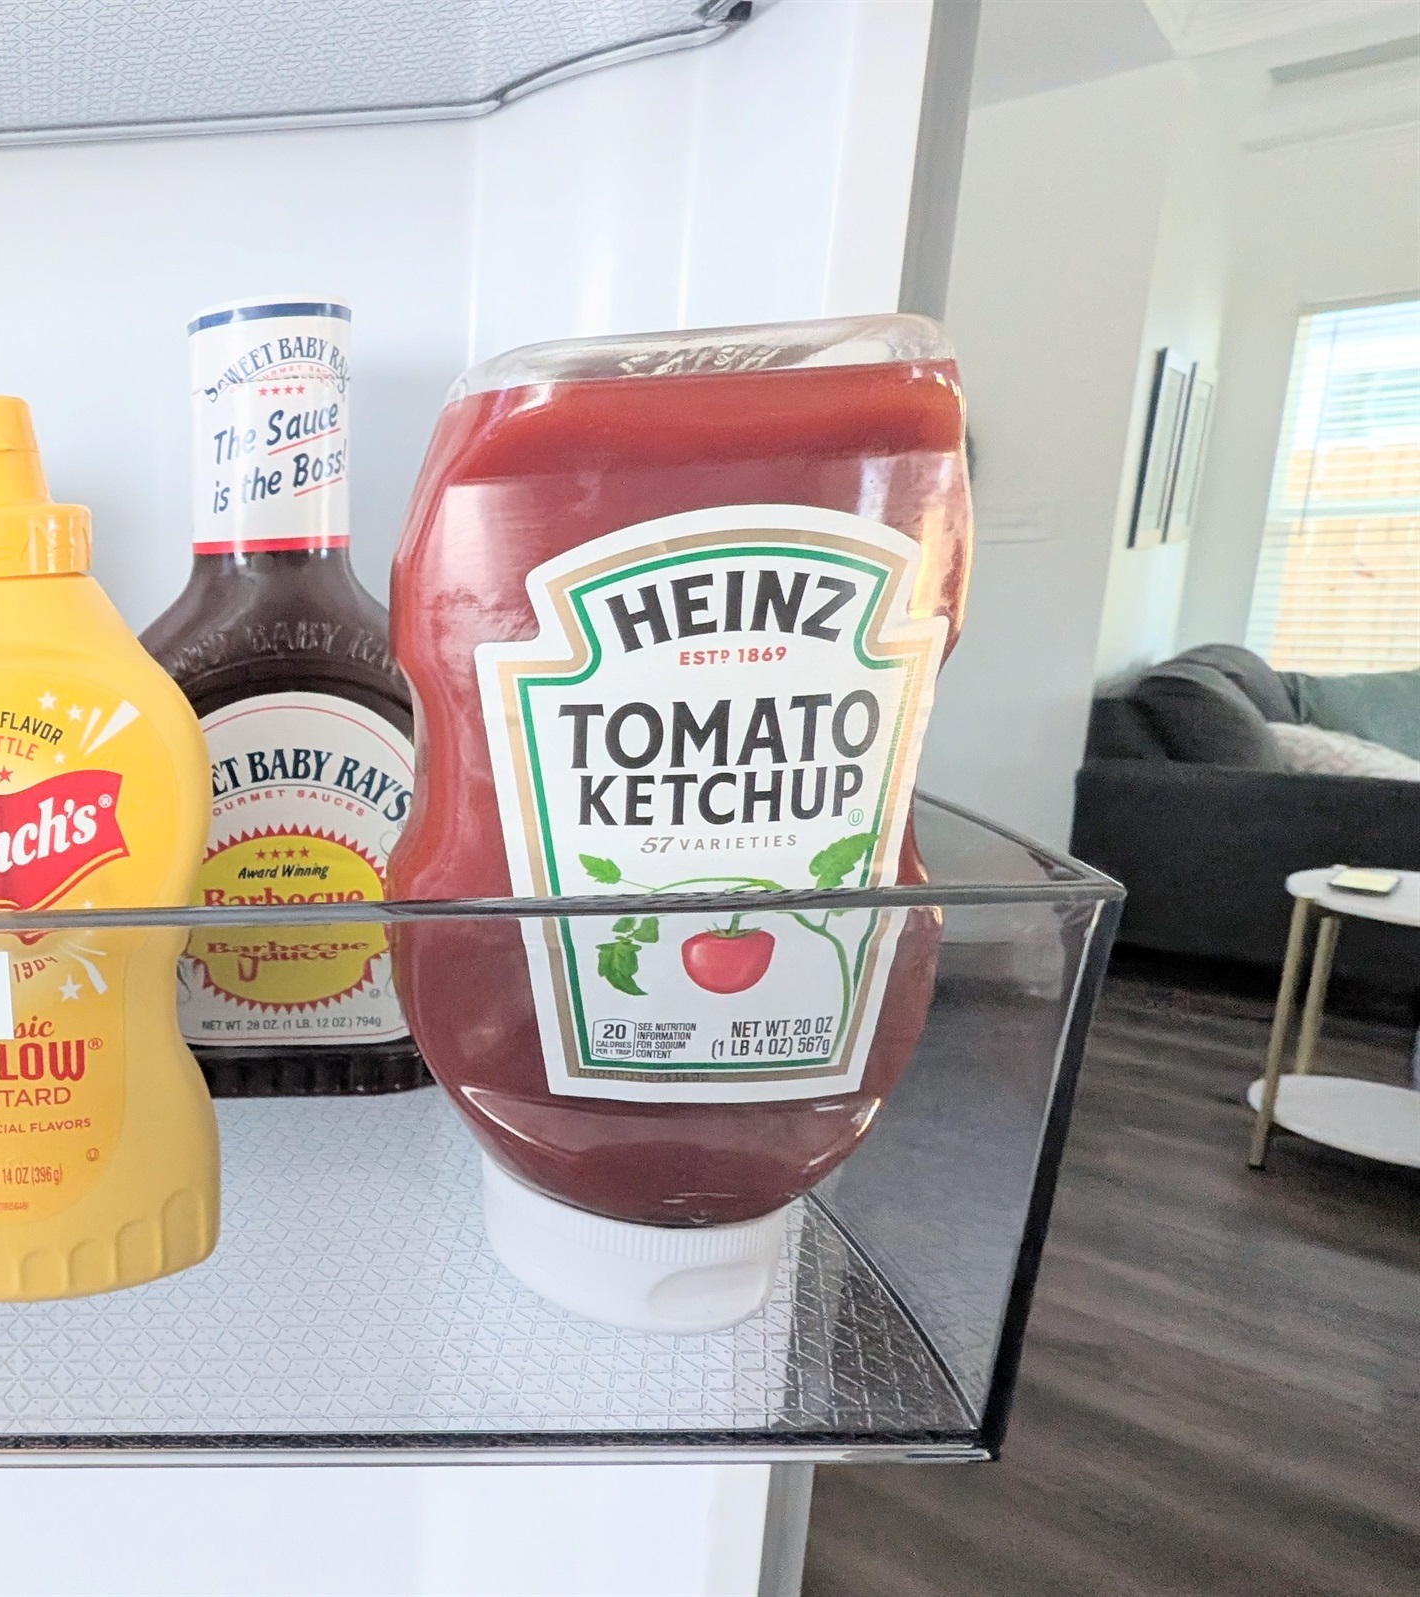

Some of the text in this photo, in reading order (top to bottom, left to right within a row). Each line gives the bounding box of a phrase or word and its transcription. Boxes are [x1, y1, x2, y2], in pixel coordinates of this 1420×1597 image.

[277, 336, 328, 361] BABY
[213, 403, 339, 466] The Sauce
[213, 438, 348, 514] is the Boss!
[604, 569, 858, 654] HEINZ
[738, 645, 788, 664] 1869
[0, 711, 64, 746] FLAVOR
[558, 689, 881, 770] TOMATO
[246, 748, 333, 783] BABY
[334, 755, 413, 822] RAY'S
[578, 763, 865, 826] KETCHUP
[212, 789, 365, 817] OURMET SAUCES
[640, 834, 798, 855] 57 VARIETIES
[238, 863, 330, 880] Award Winning
[202, 1020, 222, 1031] NET
[316, 1018, 329, 1028] 12
[603, 1023, 627, 1040] 20
[638, 1023, 697, 1031] SEE NUTRITION
[731, 1016, 833, 1039] NET WT 20 OZ
[595, 1040, 632, 1049] CALORIES
[636, 1041, 687, 1049] FOR SODIUM
[637, 1032, 691, 1040] INFORMATION
[636, 1050, 672, 1059] CONTENT
[711, 1036, 830, 1060] (1 LB 4 OZ) 567g
[29, 1117, 92, 1133] FLAVORS
[2, 1167, 13, 1184] 14
[15, 1167, 29, 1184] OZ
